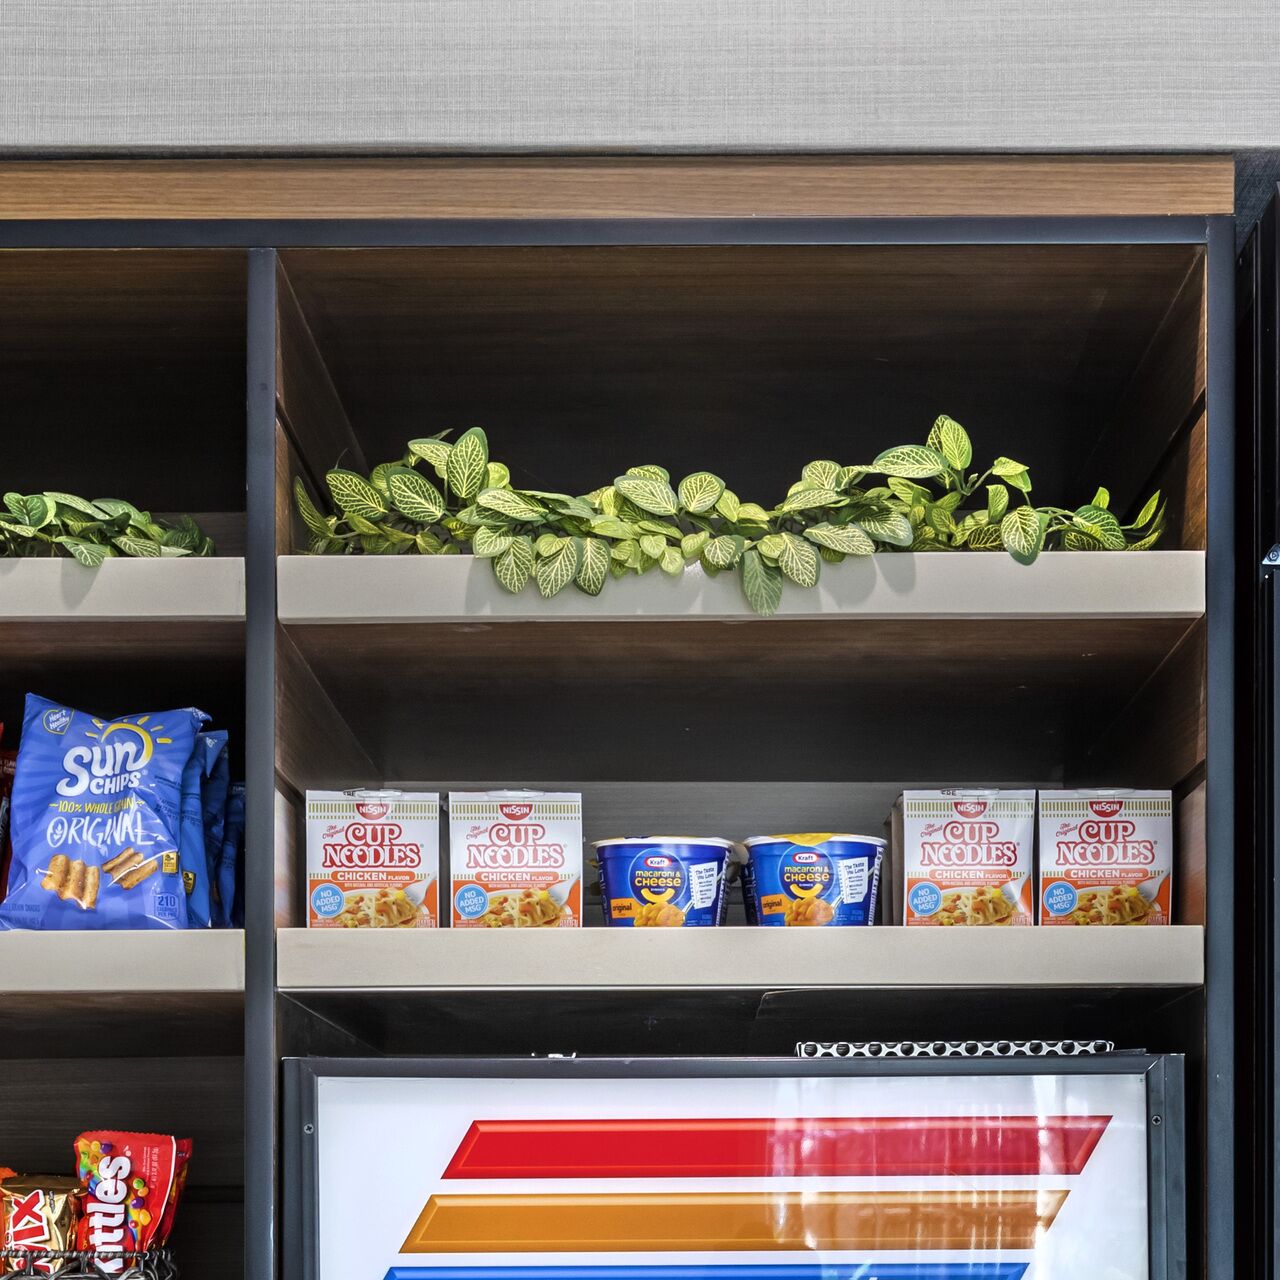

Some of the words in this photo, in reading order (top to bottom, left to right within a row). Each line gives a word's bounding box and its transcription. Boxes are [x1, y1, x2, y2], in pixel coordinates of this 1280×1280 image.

[56, 741, 143, 796] Sun
[89, 772, 142, 795] CHIPS
[58, 801, 82, 813] 100%
[84, 800, 112, 814] WHOLE
[360, 805, 386, 814] NISSIN
[503, 806, 529, 815] NISSIN
[957, 803, 984, 813] NISSIN
[1093, 802, 1119, 812] NISSIN
[47, 811, 155, 848] ORIGINAL
[346, 823, 402, 846] CUP
[489, 823, 545, 846] CUP
[943, 821, 999, 844] CUP
[1079, 820, 1135, 843] CUP
[322, 844, 421, 868] NOODLES
[466, 844, 564, 868] NOODLES
[921, 842, 1017, 867] NOODLES
[1056, 840, 1155, 866] NOODLES
[337, 872, 386, 880] CHICKEN
[935, 871, 984, 879] CHICKEN
[1071, 870, 1120, 878] CHICKEN
[919, 888, 929, 896] NO
[158, 895, 176, 907] 210
[316, 896, 340, 906] ADDED
[460, 896, 484, 907] ADDED
[763, 899, 782, 909] original
[913, 894, 937, 904] ADDED
[1049, 894, 1072, 904] ADDED
[321, 904, 338, 912] MSG
[465, 905, 481, 913] MSG
[613, 903, 632, 913] original
[918, 902, 935, 910] MSG
[1054, 901, 1069, 910] MSG
